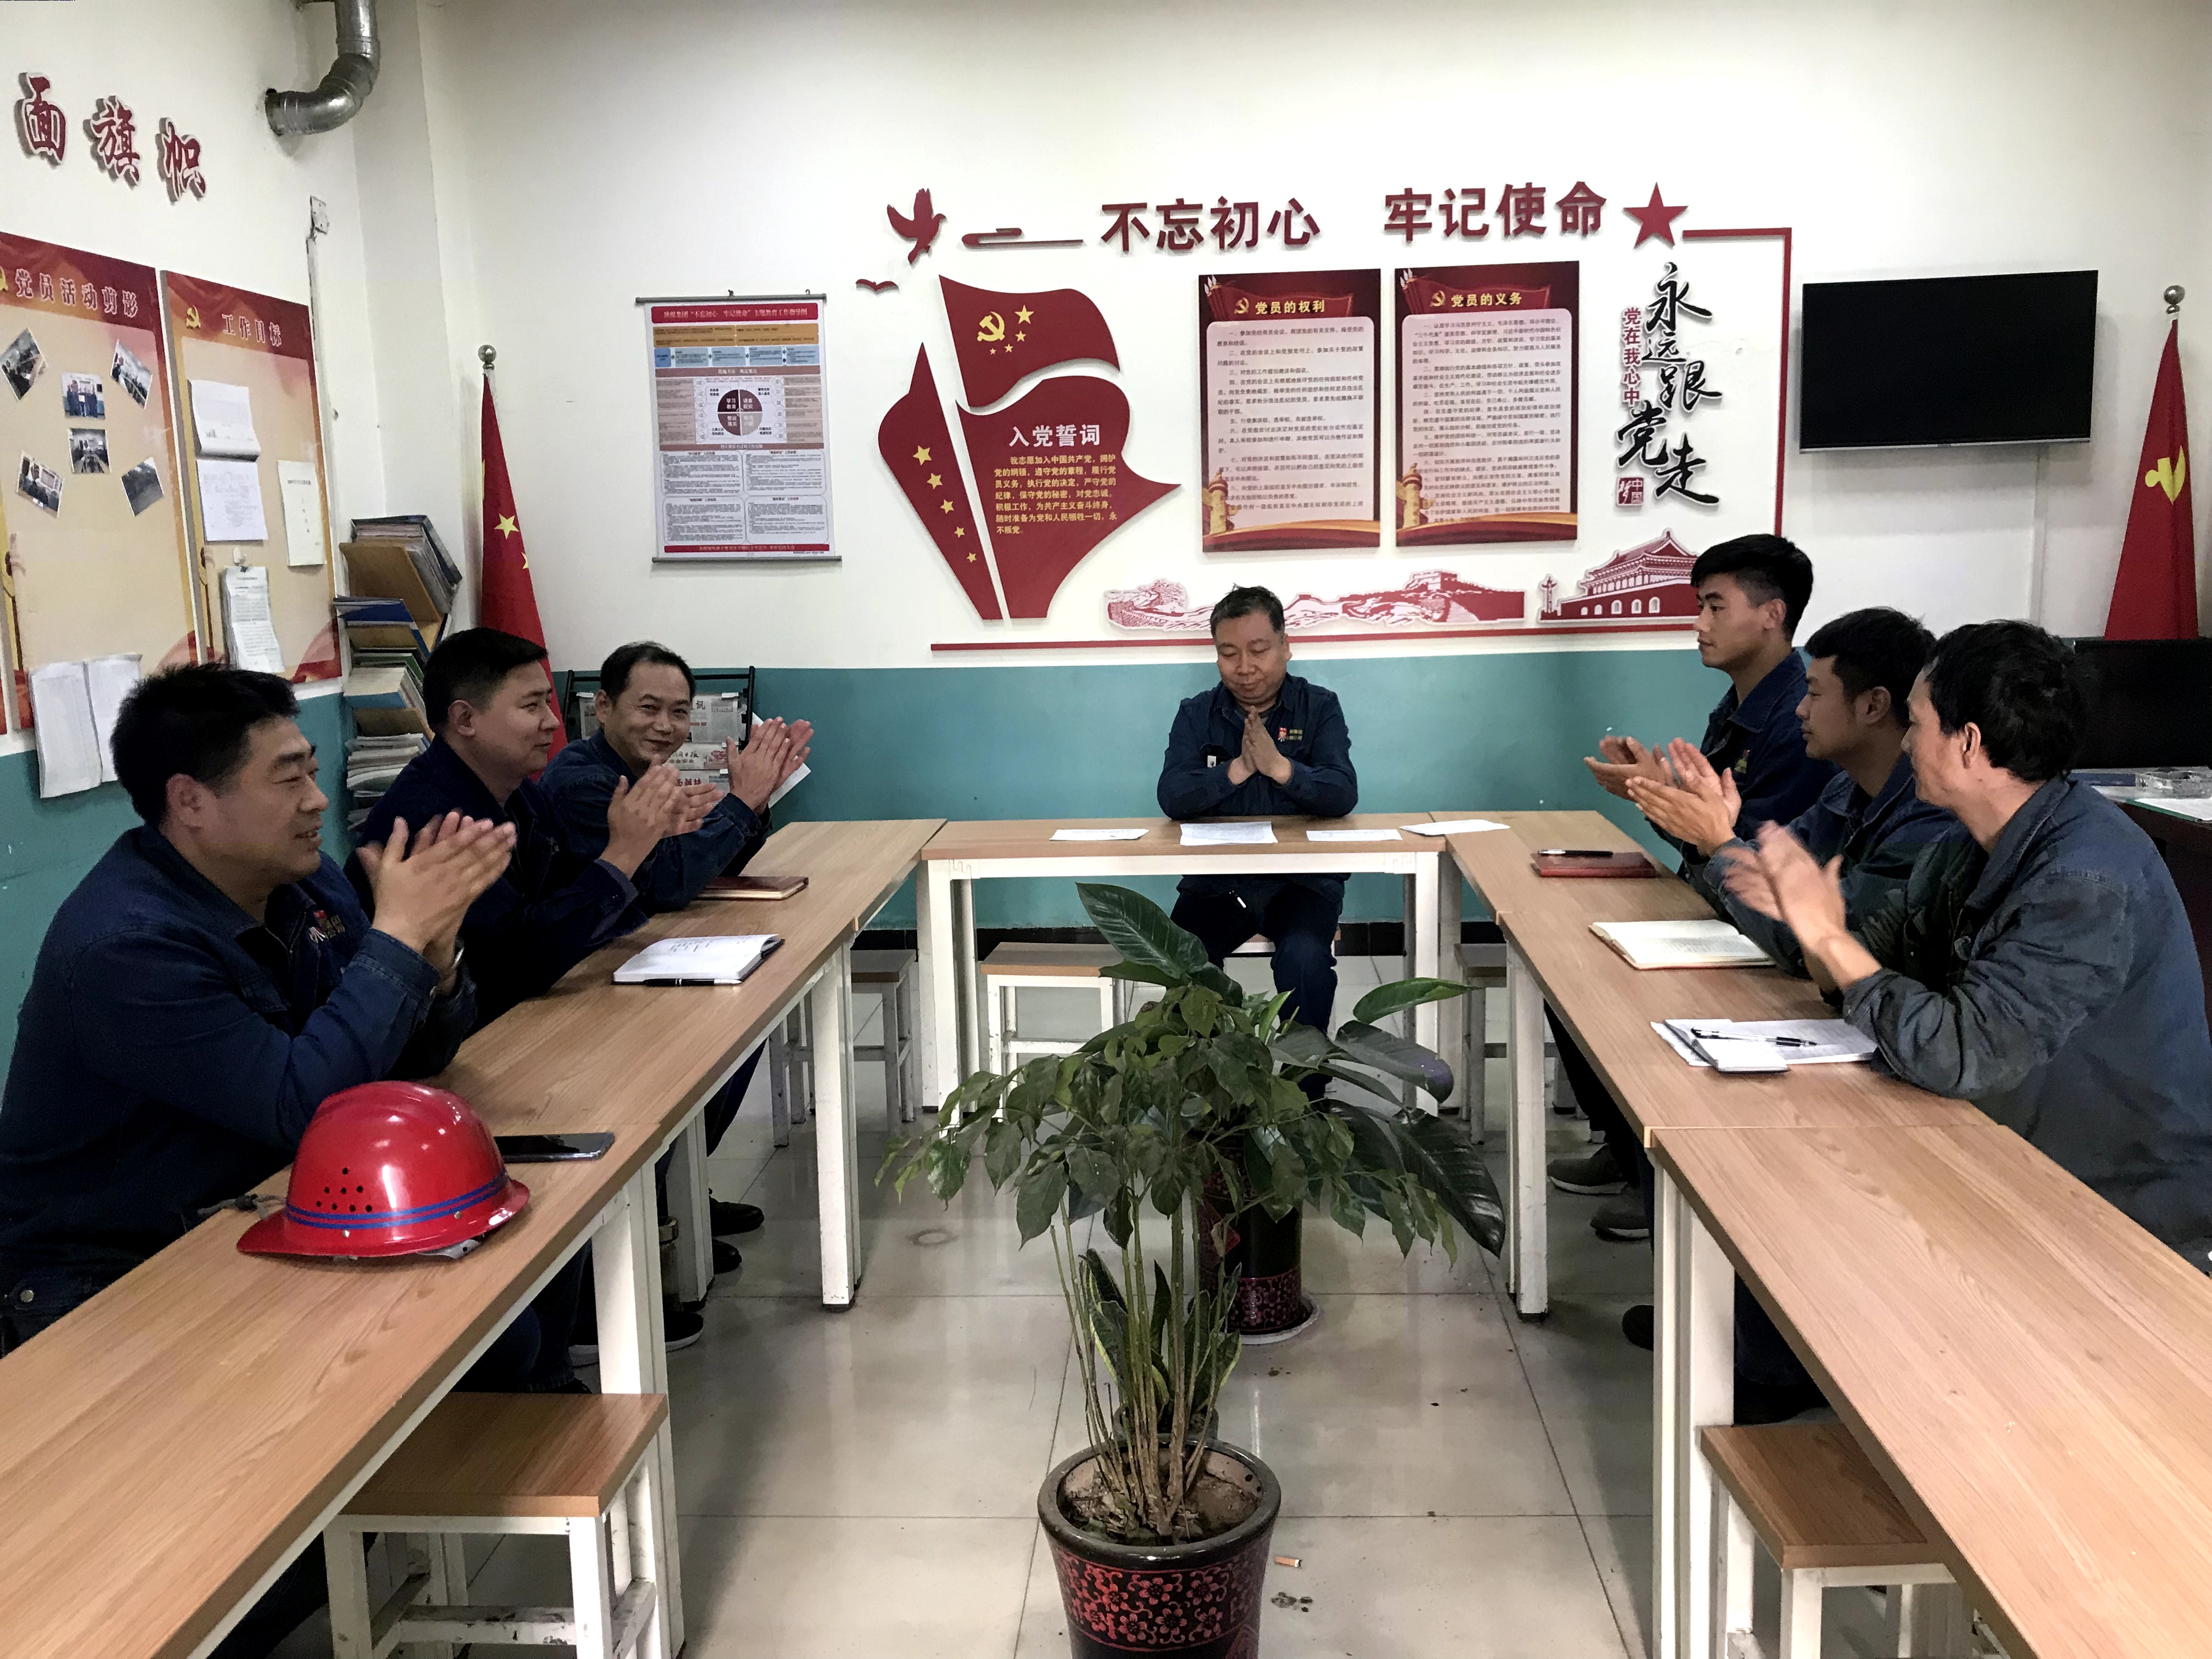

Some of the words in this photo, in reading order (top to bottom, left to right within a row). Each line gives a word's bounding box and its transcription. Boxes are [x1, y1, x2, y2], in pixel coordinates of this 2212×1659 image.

[25, 76, 207, 199] 面旗帜
[1102, 196, 1320, 252] 不忘初心
[1384, 181, 1606, 241] 牢记使命
[15, 268, 139, 318] 党员活动剪影
[1255, 300, 1325, 315] 党员的权利
[1451, 292, 1522, 307] 党员的义务
[222, 313, 283, 347] 工作目标
[1623, 307, 1641, 406] 党在我心中
[1617, 262, 1722, 504] 永远跟党走
[1008, 424, 1101, 448] 入党誓词
